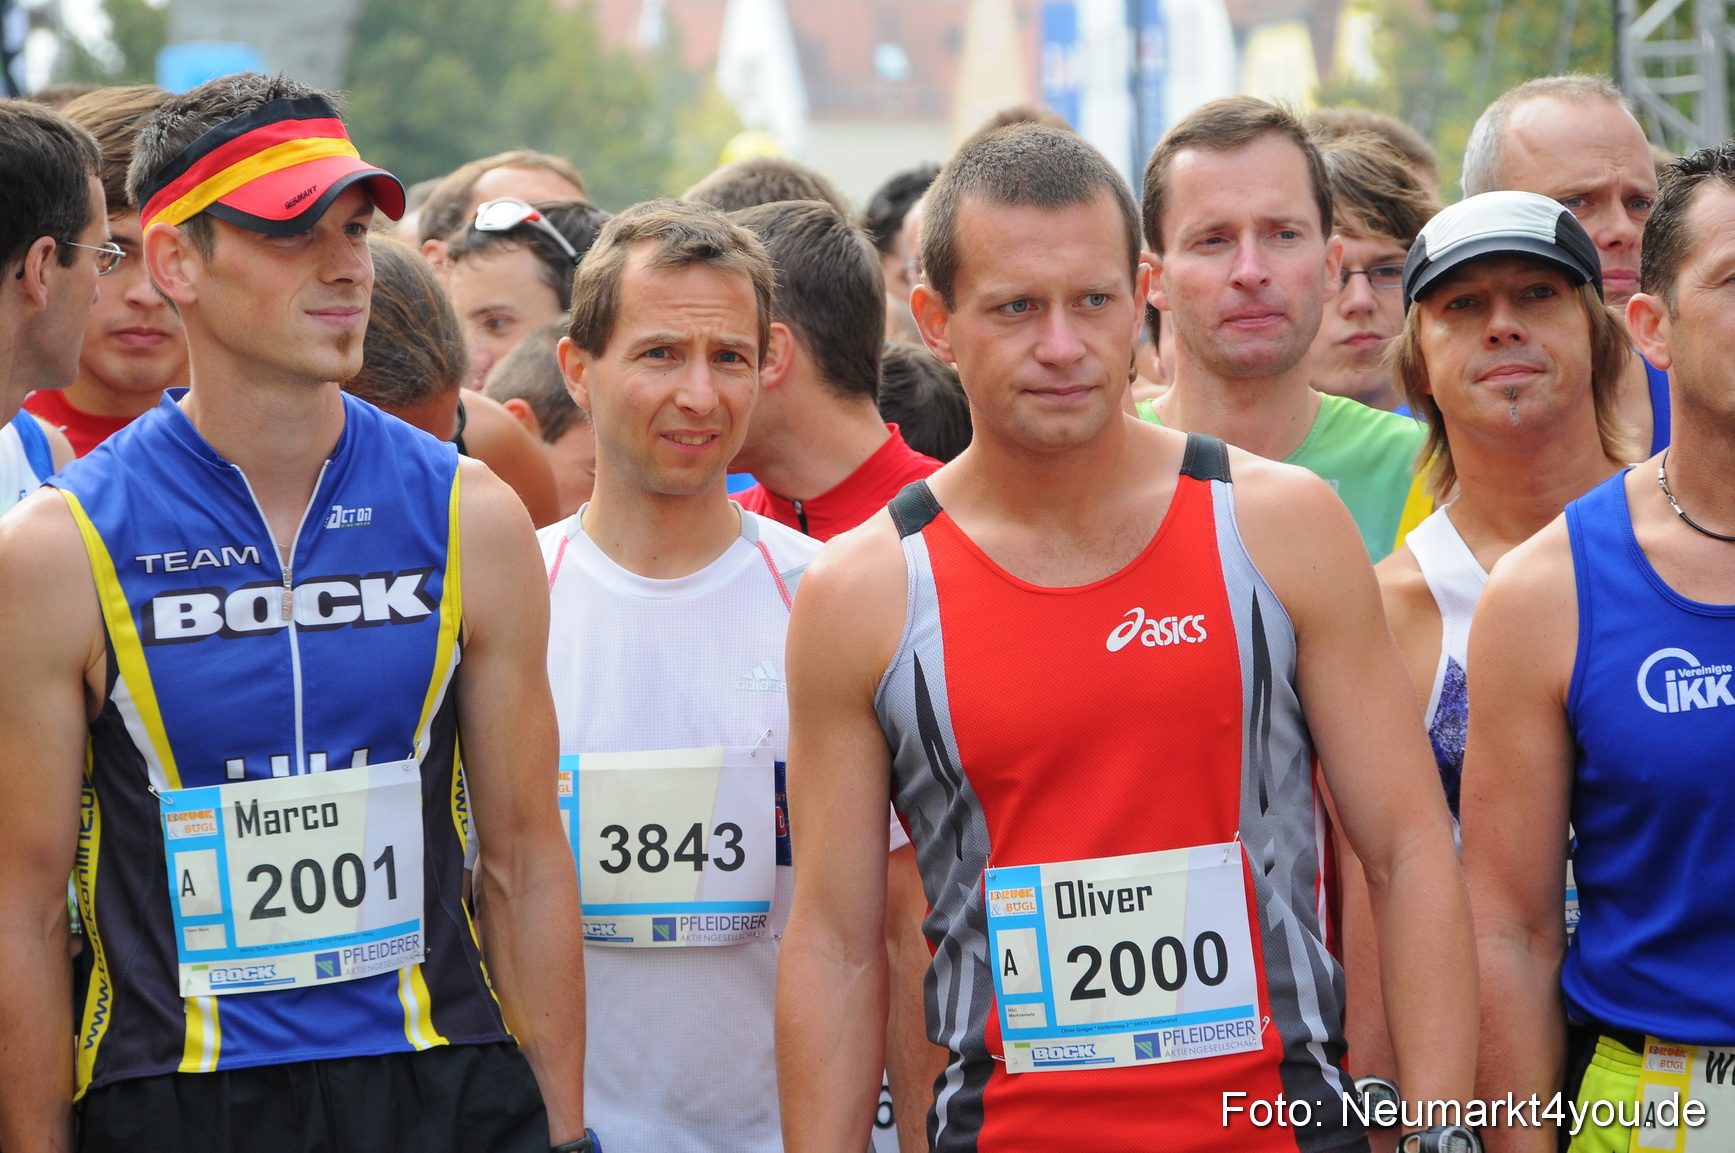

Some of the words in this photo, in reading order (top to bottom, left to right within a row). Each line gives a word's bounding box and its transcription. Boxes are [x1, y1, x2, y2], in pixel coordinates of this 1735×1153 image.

[284, 184, 317, 210] GERMANY
[135, 545, 261, 574] TEAM
[147, 571, 437, 643] BOCK
[1140, 614, 1207, 648] asics
[1677, 664, 1733, 678] Vereinigte
[234, 798, 339, 838] Marco
[599, 822, 746, 874] 3843
[181, 869, 196, 897] A
[246, 845, 398, 921] 2001
[1054, 879, 1153, 920] Oliver
[680, 914, 767, 932] PFLEIDERER
[343, 934, 420, 965] PFLEIDERER
[1003, 948, 1019, 977] A
[209, 964, 276, 983] BOCK
[1066, 930, 1229, 1001] 2000
[1162, 1019, 1256, 1047] PFLEIDERER
[1031, 1043, 1097, 1061] BOCK
